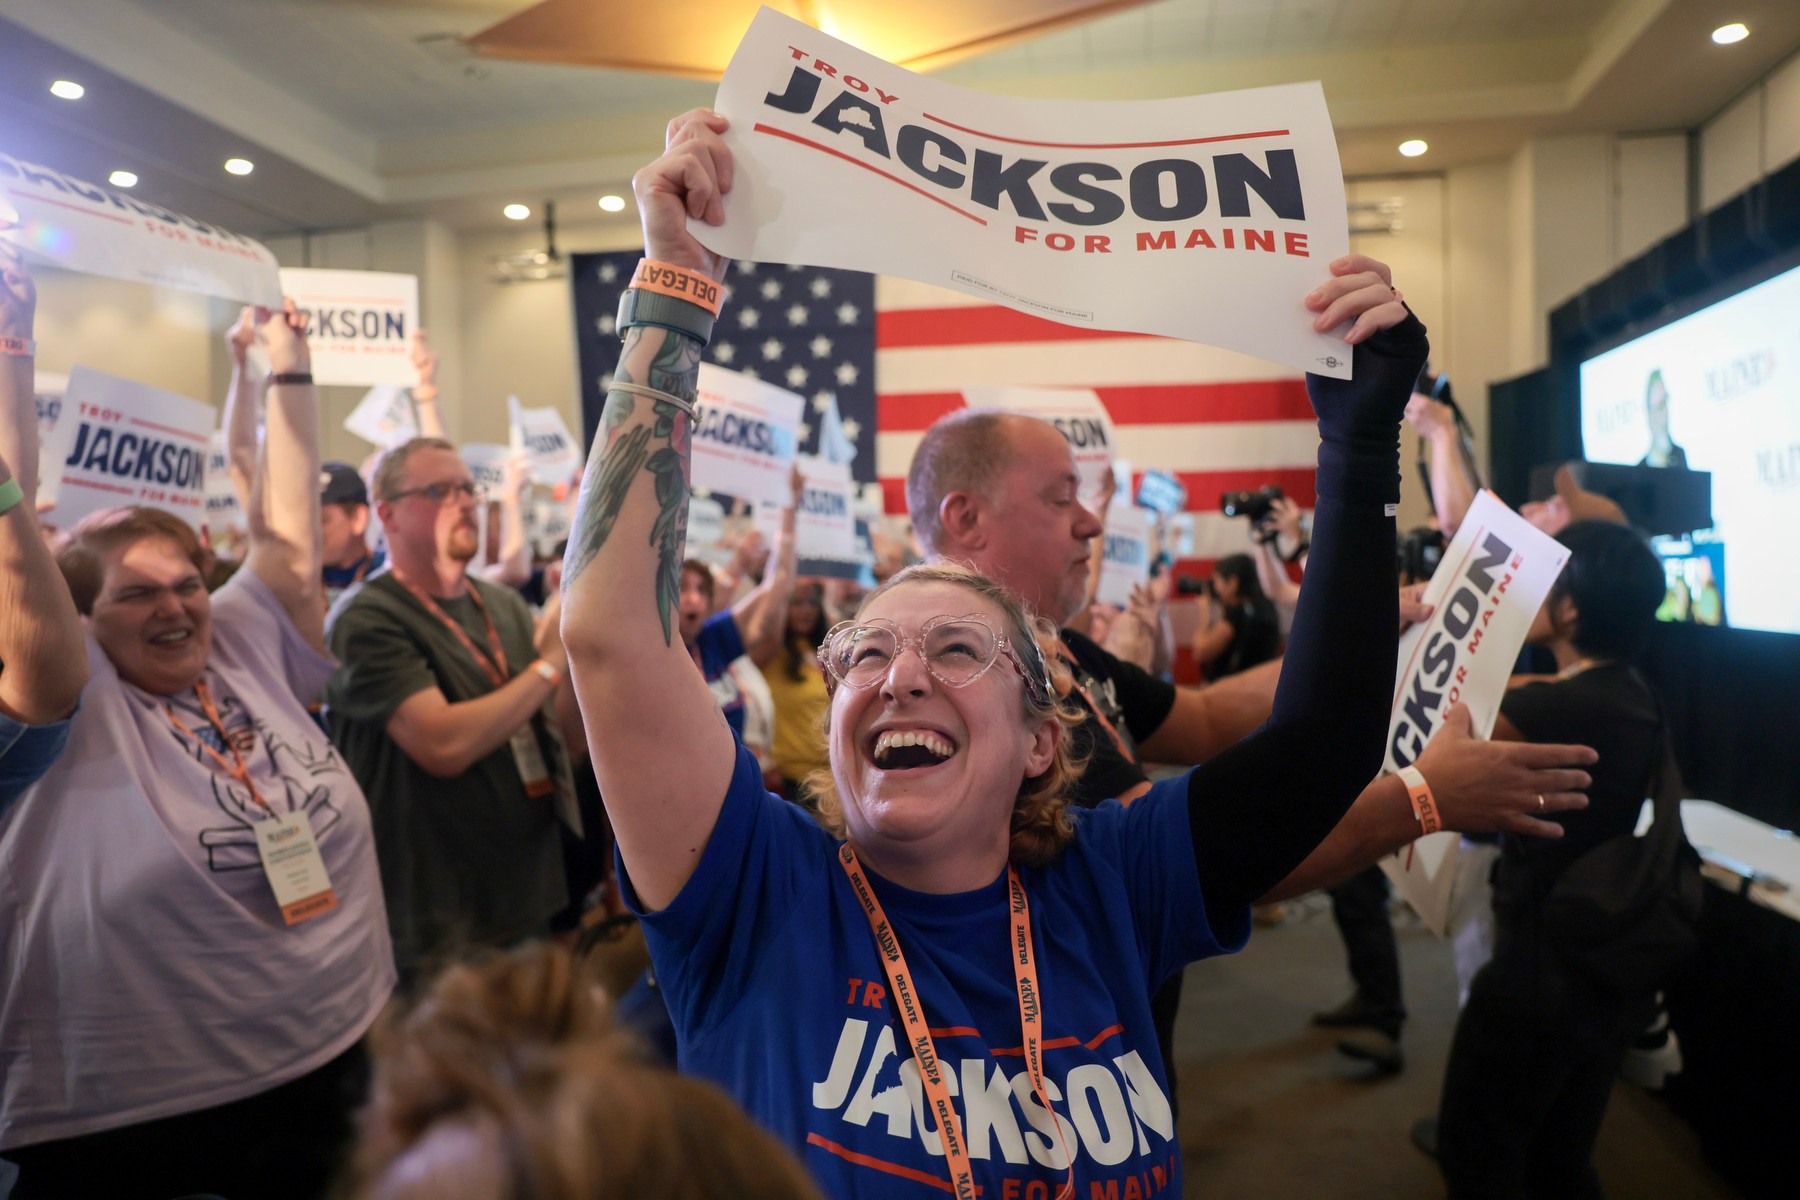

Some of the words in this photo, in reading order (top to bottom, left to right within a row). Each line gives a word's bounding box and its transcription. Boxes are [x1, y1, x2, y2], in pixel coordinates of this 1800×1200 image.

[788, 45, 899, 106] TROY
[764, 65, 1306, 226] JACKSON
[1015, 226, 1112, 254] FOR
[1136, 228, 1310, 257] MAINE
[79, 401, 123, 423] TROY
[66, 423, 205, 489] JACKSON
[1468, 552, 1524, 655] MAINE
[1390, 532, 1512, 768] CKSON
[1017, 925, 1028, 965] DELEGATE
[847, 978, 890, 1012] TR
[851, 872, 876, 914] DELEGATE
[877, 920, 898, 957] MAINE
[895, 974, 919, 1024] DELEGATE
[916, 1035, 939, 1077] MAINE
[936, 1100, 960, 1156] DELEGATE
[1021, 984, 1036, 1024] MAINE
[1028, 1038, 1043, 1091] DELEGATE
[812, 1017, 1174, 1170] JACKSON
[1090, 1154, 1175, 1200] MAIN
